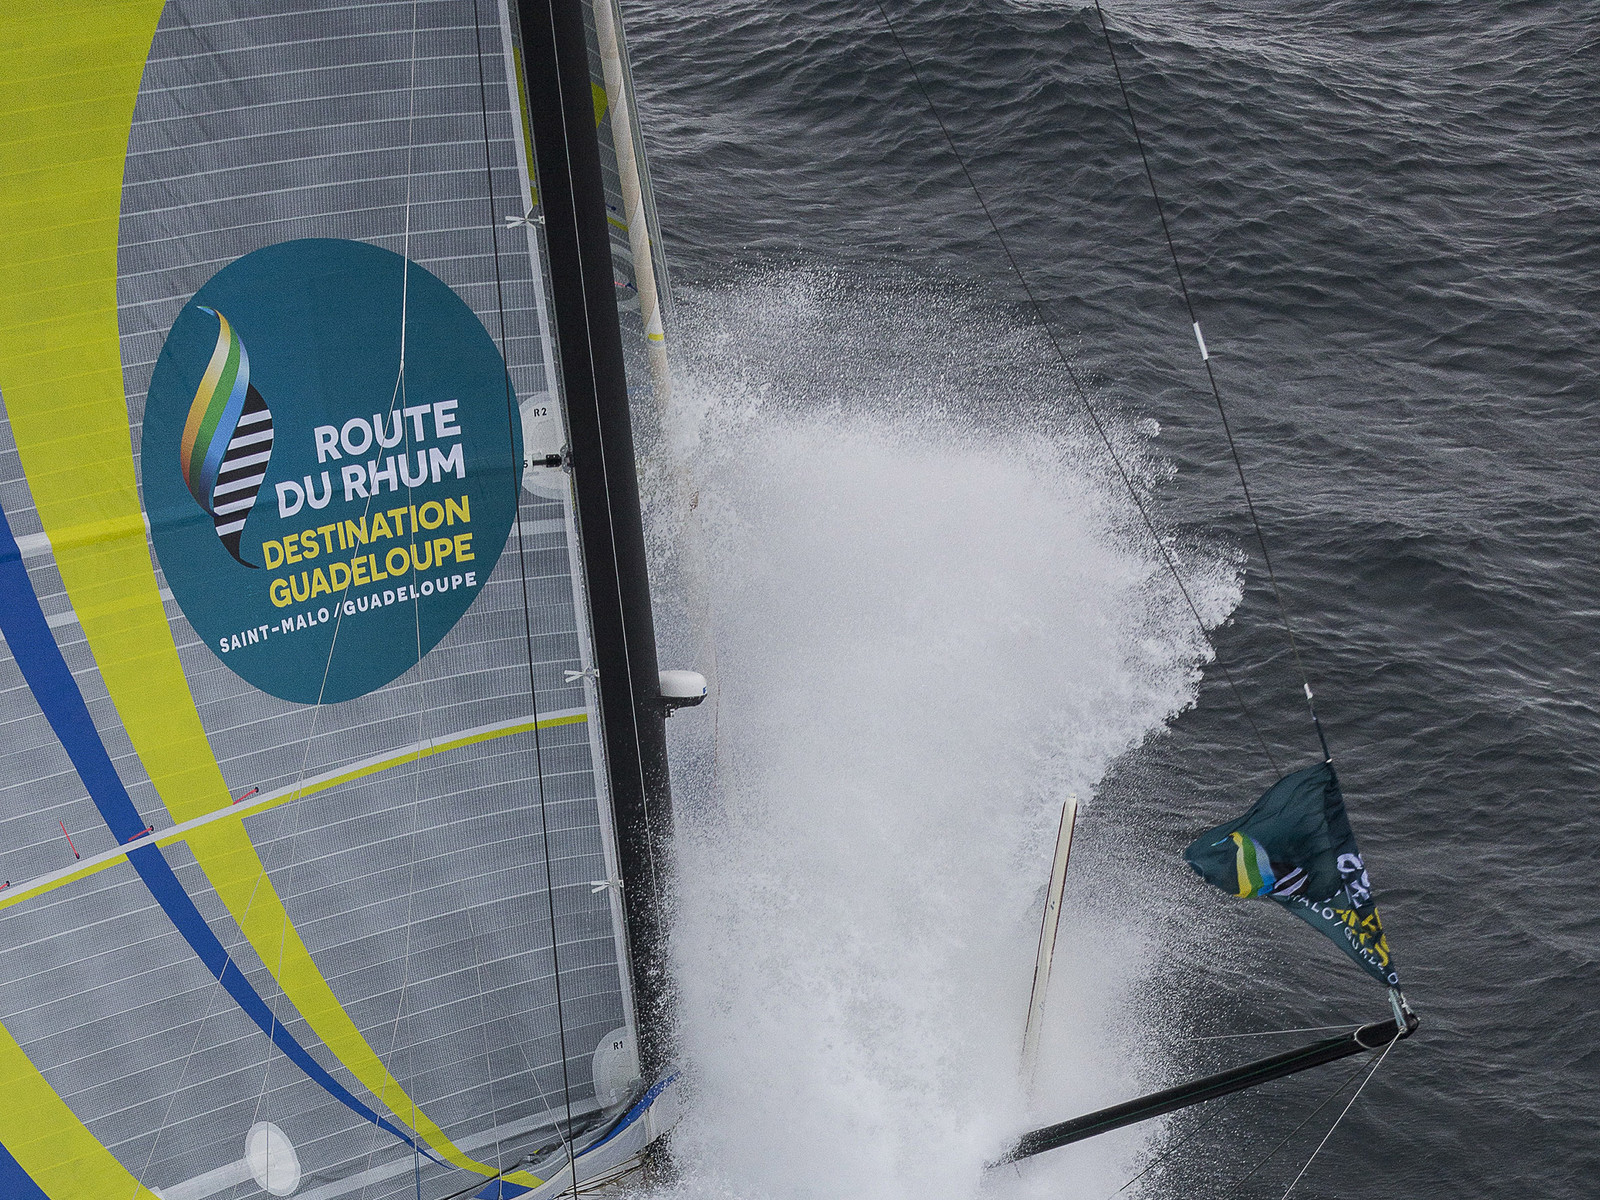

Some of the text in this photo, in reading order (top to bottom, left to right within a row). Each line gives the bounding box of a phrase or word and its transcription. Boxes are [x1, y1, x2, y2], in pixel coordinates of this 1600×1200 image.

[313, 399, 461, 464] ROUTE
[275, 443, 467, 519] DU RHUM
[262, 494, 472, 571] DESTINATION
[269, 532, 476, 609] GUADELOUPE
